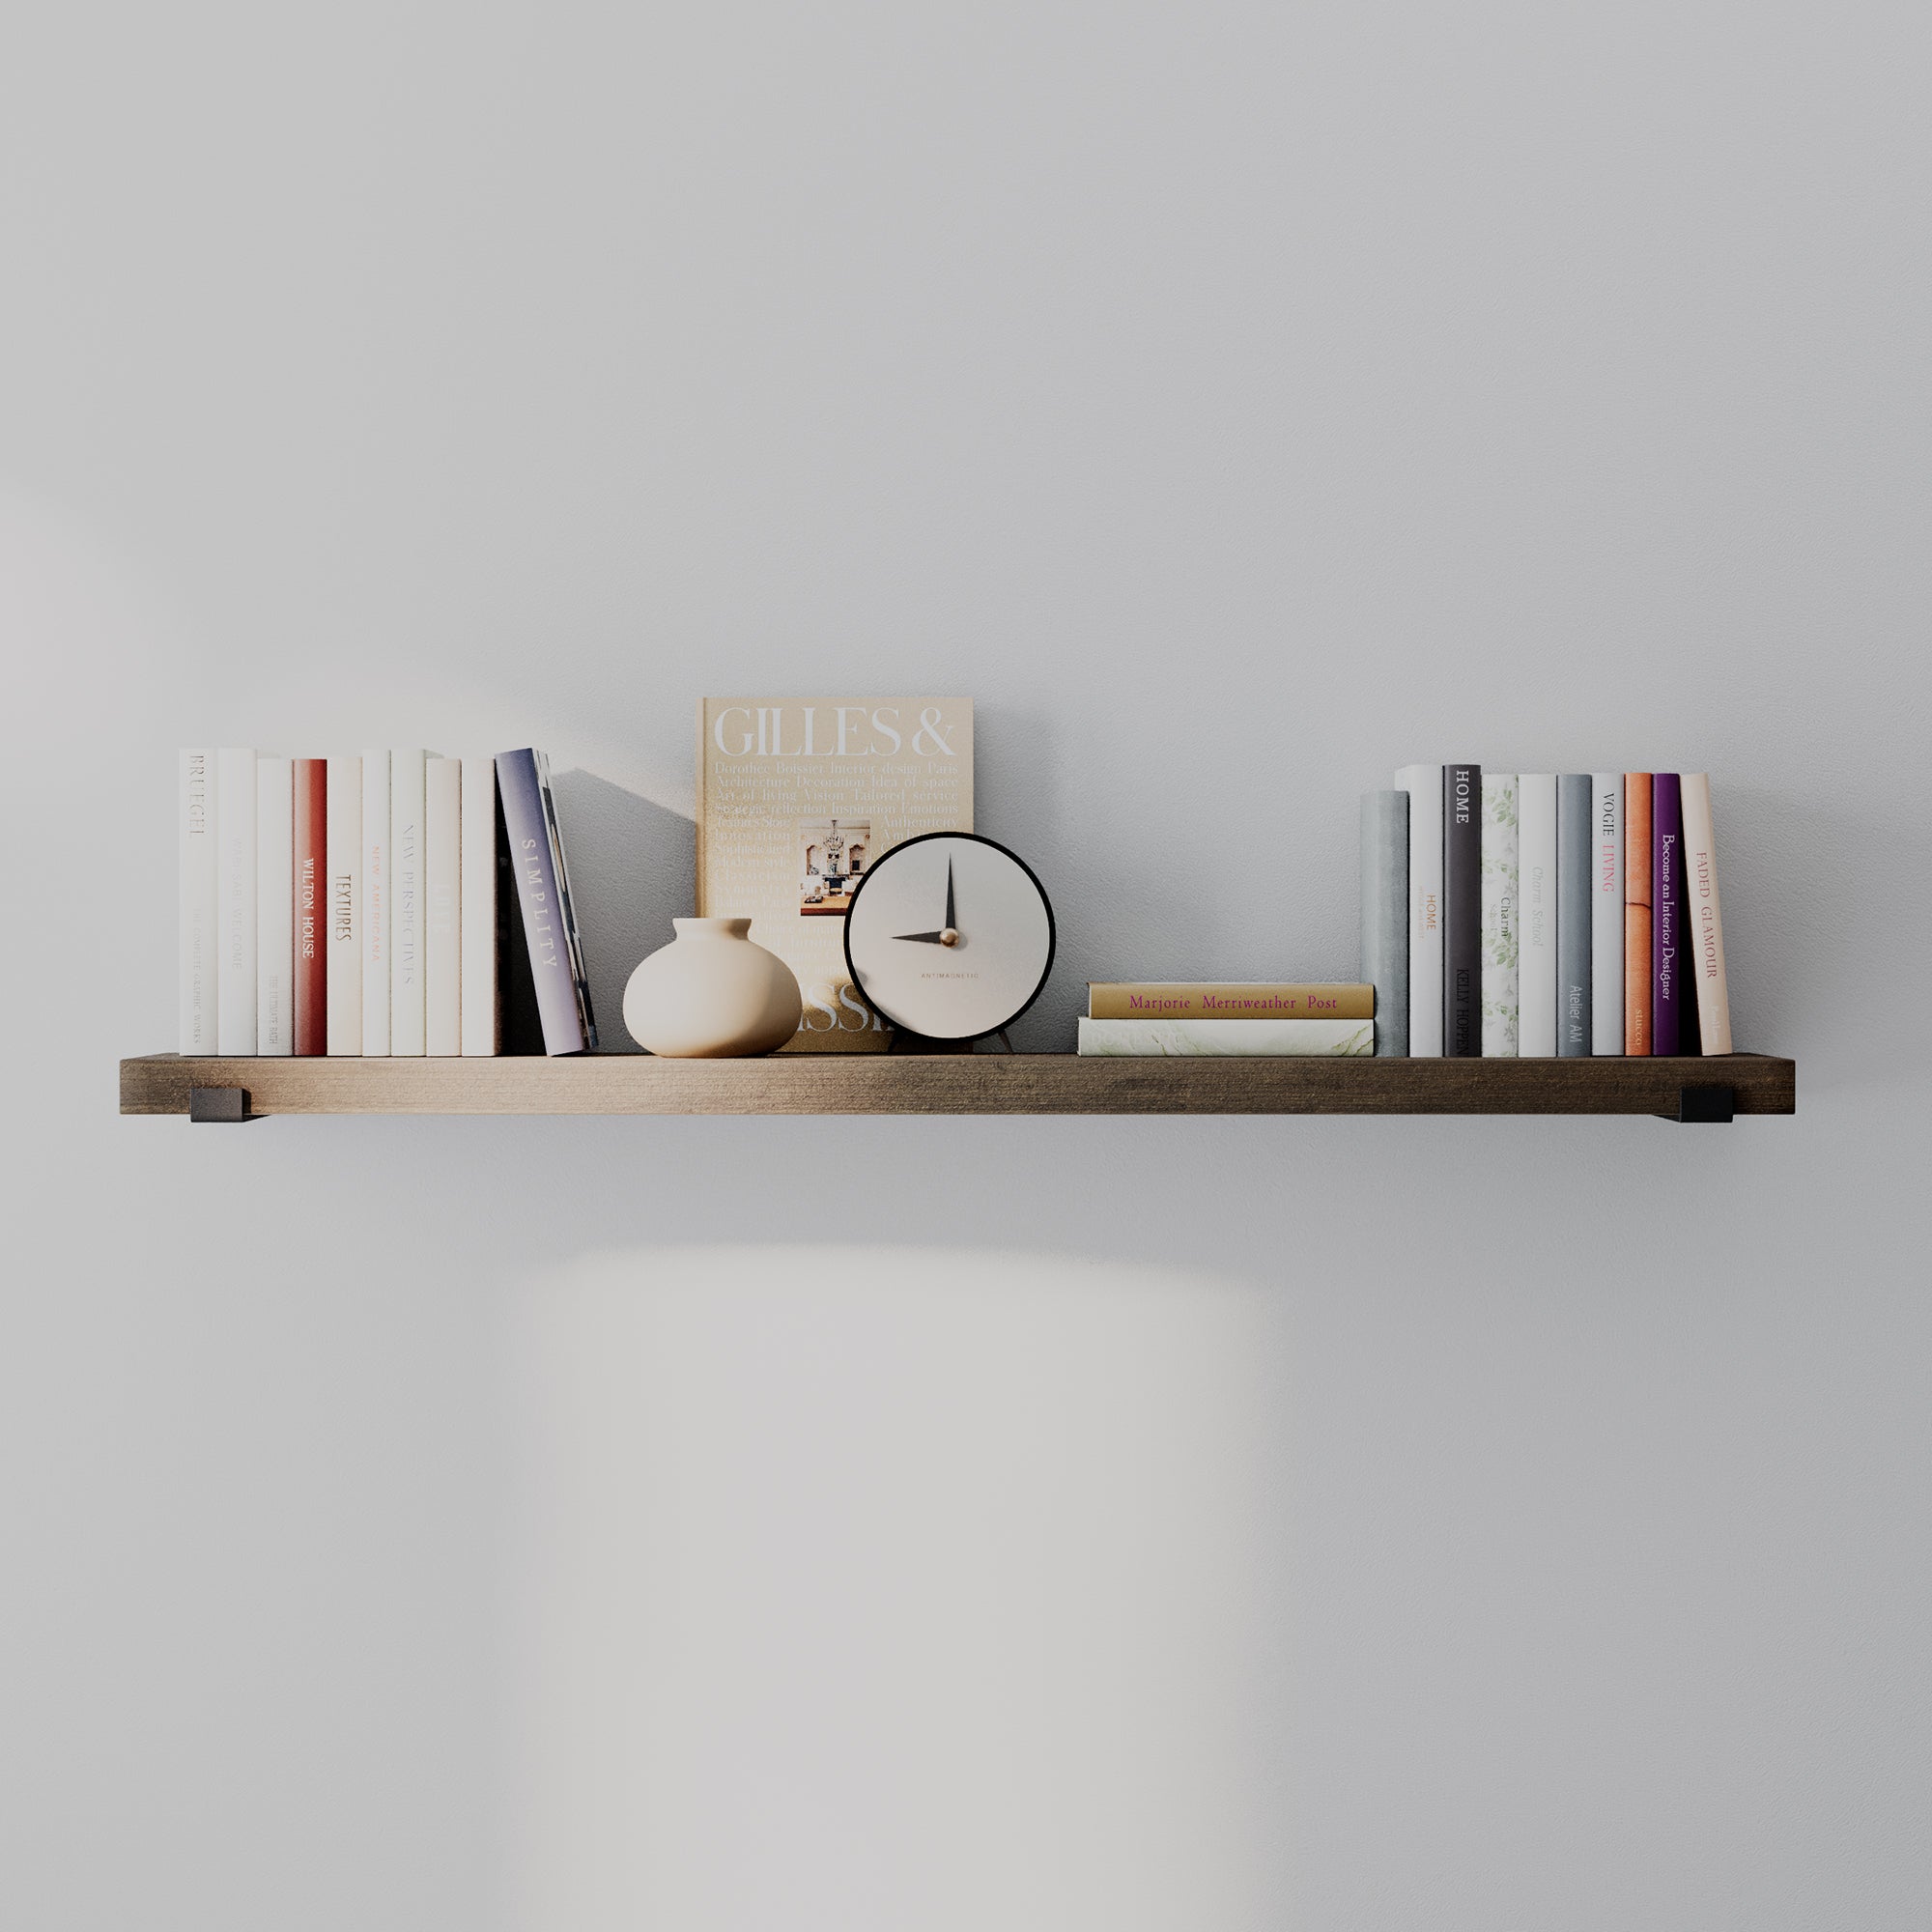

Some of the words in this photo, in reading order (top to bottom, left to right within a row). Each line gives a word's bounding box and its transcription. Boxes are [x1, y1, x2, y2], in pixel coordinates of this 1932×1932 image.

[714, 707, 901, 757] GILLES
[911, 706, 957, 757] &
[717, 776, 789, 787] Architecture
[796, 776, 865, 787] Decoration
[904, 776, 917, 787] of
[923, 779, 958, 790] space
[830, 761, 875, 774] Interior
[881, 761, 922, 777] design
[926, 761, 958, 774] Paris
[189, 754, 205, 838] BRUEGEL
[770, 802, 826, 813] reflection
[832, 802, 895, 815] Inspiration
[900, 802, 958, 813] Emotions
[804, 788, 843, 801] Vision
[854, 788, 905, 801] Tailored
[912, 790, 958, 801] service
[1456, 770, 1469, 824] HOME
[372, 846, 381, 877] NEW
[402, 824, 414, 863] NEW
[1662, 834, 1675, 882] Become
[301, 858, 314, 910] WILTON
[1603, 844, 1615, 893] LIVING
[1696, 852, 1710, 898] FADED
[335, 874, 351, 941] TEXTURES
[522, 838, 557, 968] SIMPLITY
[1427, 895, 1437, 930] HOME
[1662, 885, 1671, 898] an
[301, 917, 314, 958] HOUSE
[372, 883, 381, 962] AMERICANA
[402, 871, 414, 985] PERSPECTIVES
[1501, 896, 1511, 937] Charm
[1662, 901, 1675, 946] Interior
[1701, 906, 1719, 979] GLAMOUR
[1456, 969, 1468, 1003] KELLY
[1659, 948, 1675, 1000] Designer
[1129, 995, 1191, 1012] Marjorie
[1202, 995, 1296, 1009] Merriweather
[1307, 995, 1338, 1009] Post
[1569, 984, 1581, 1019] Atelier
[1456, 1009, 1469, 1056] HOPPEN
[1570, 1024, 1581, 1042] AM
